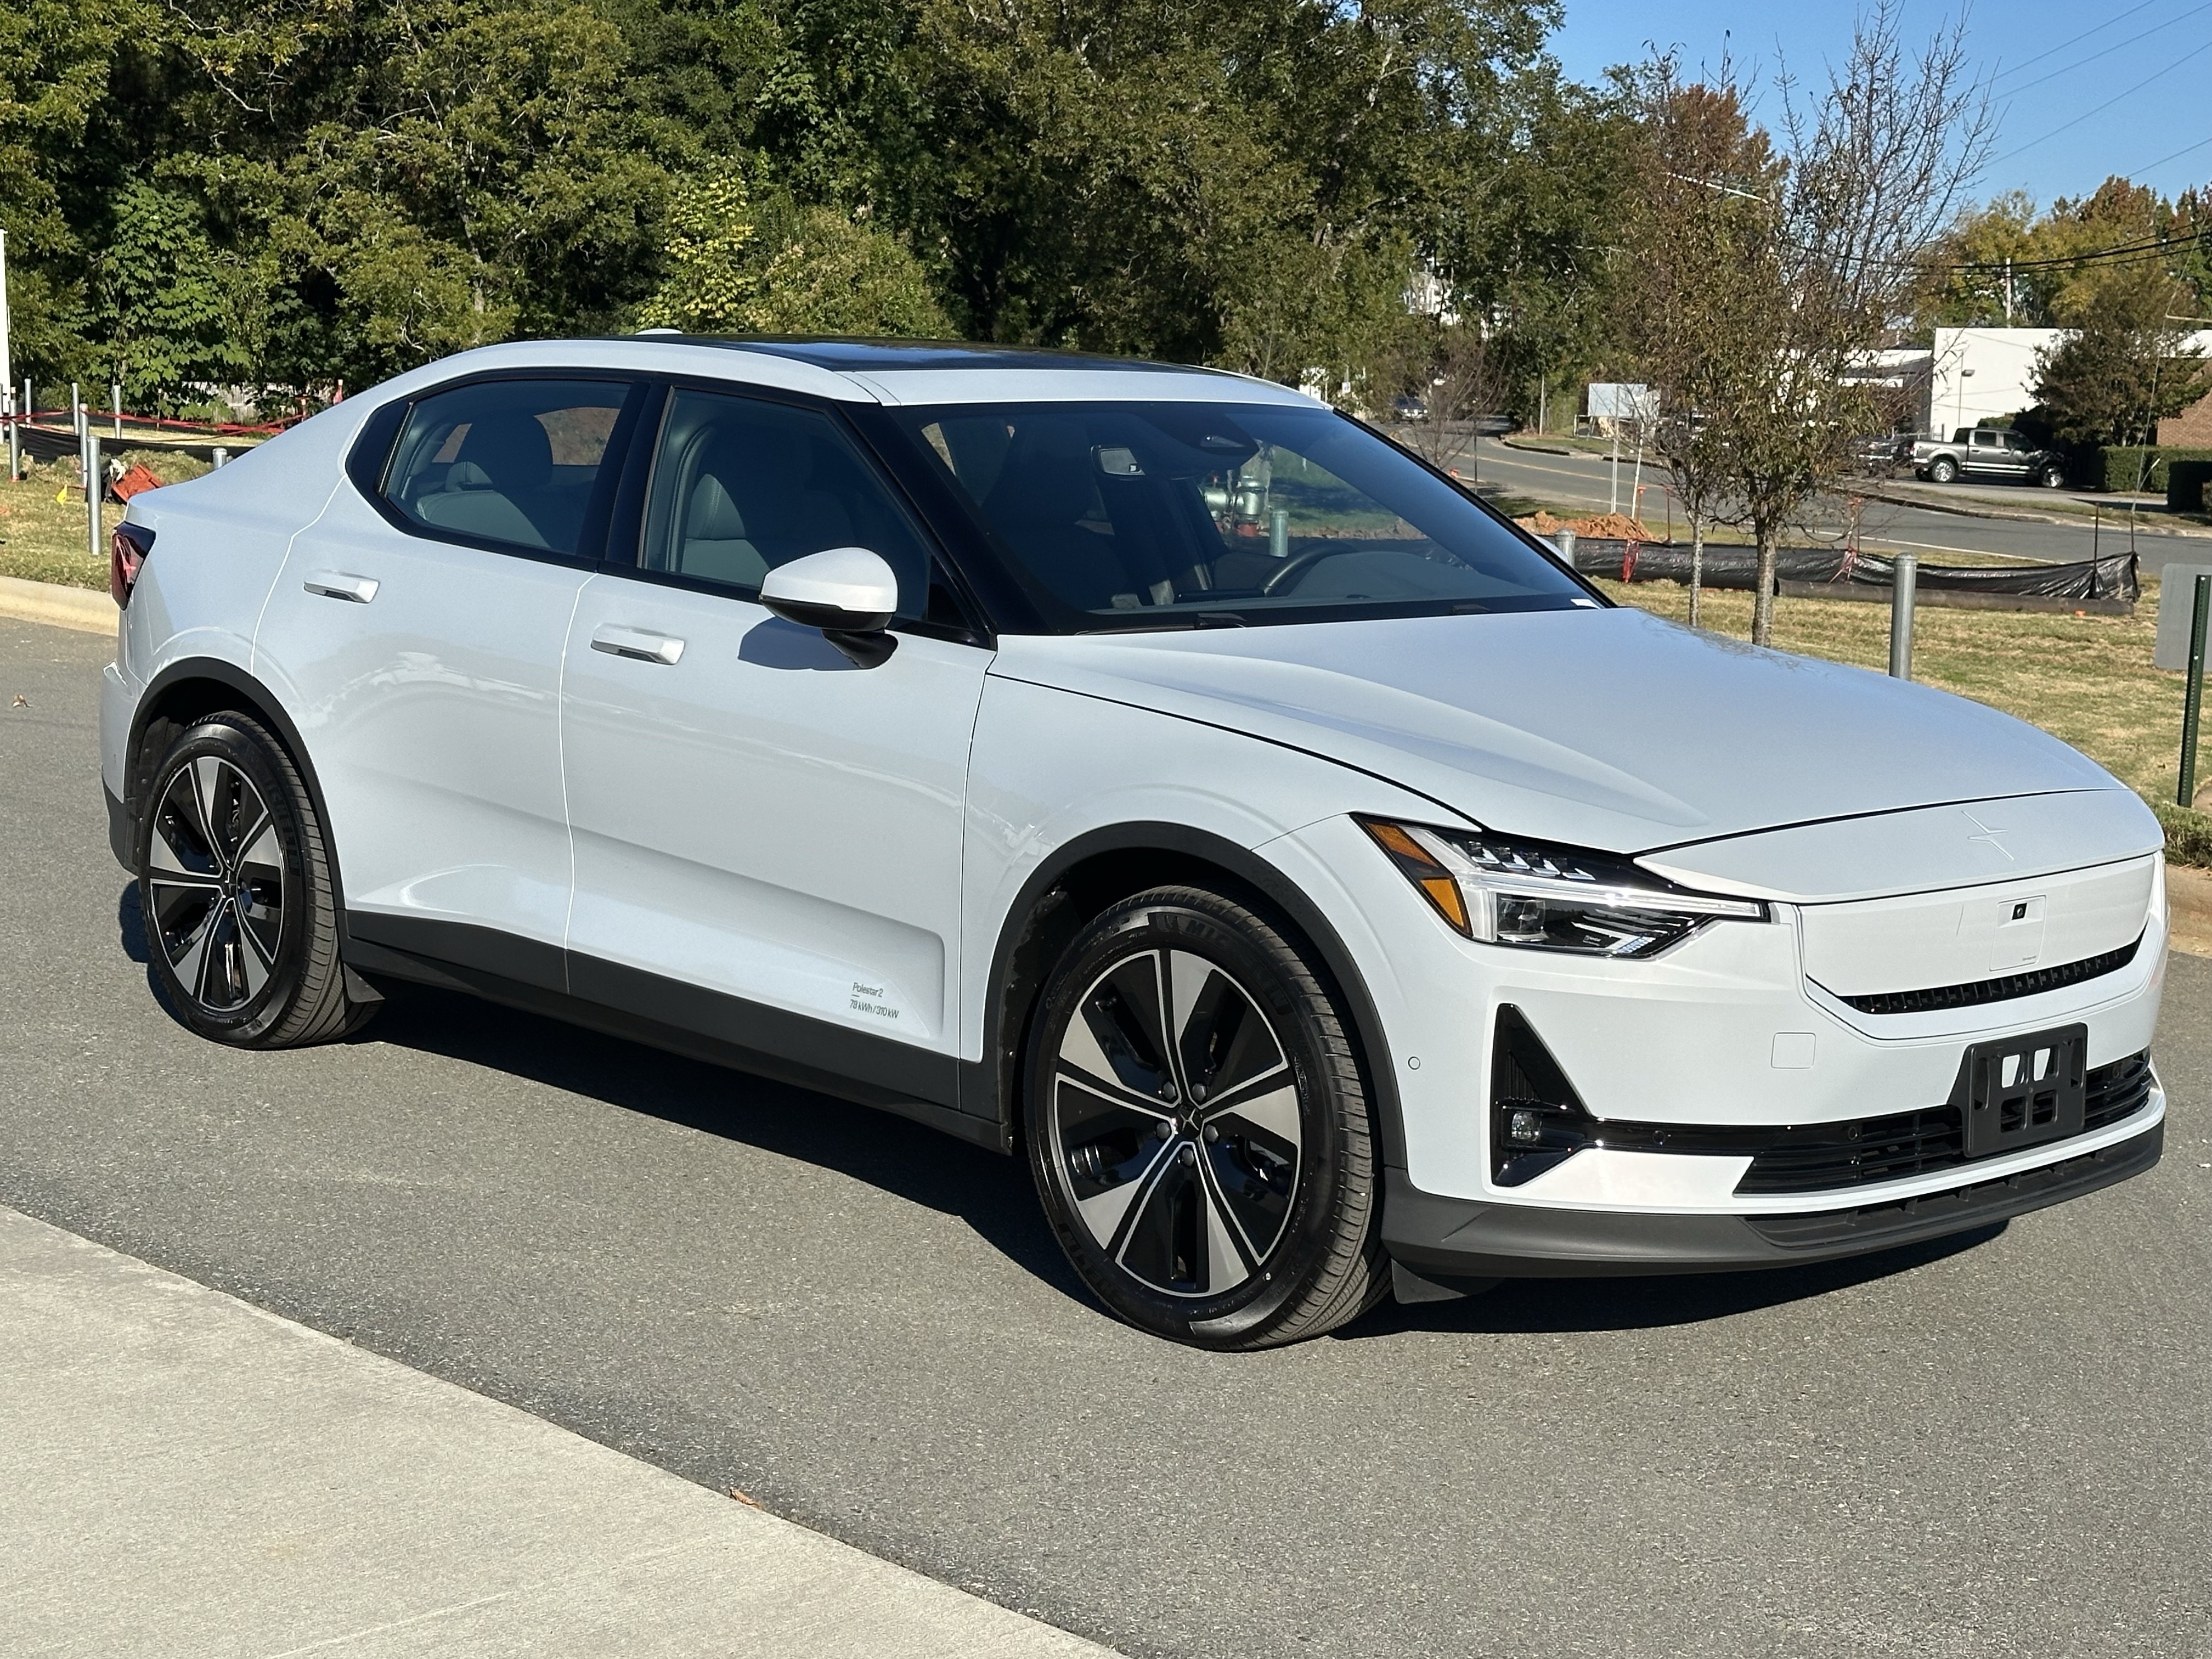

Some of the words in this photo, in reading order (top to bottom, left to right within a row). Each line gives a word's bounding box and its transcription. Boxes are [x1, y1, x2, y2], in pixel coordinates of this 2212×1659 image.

[853, 982, 879, 996] Polestar
[878, 988, 883, 997] 2
[850, 999, 858, 1009] 78
[858, 1002, 872, 1013] kWh
[876, 1006, 887, 1017] 310
[888, 1009, 900, 1019] kW
